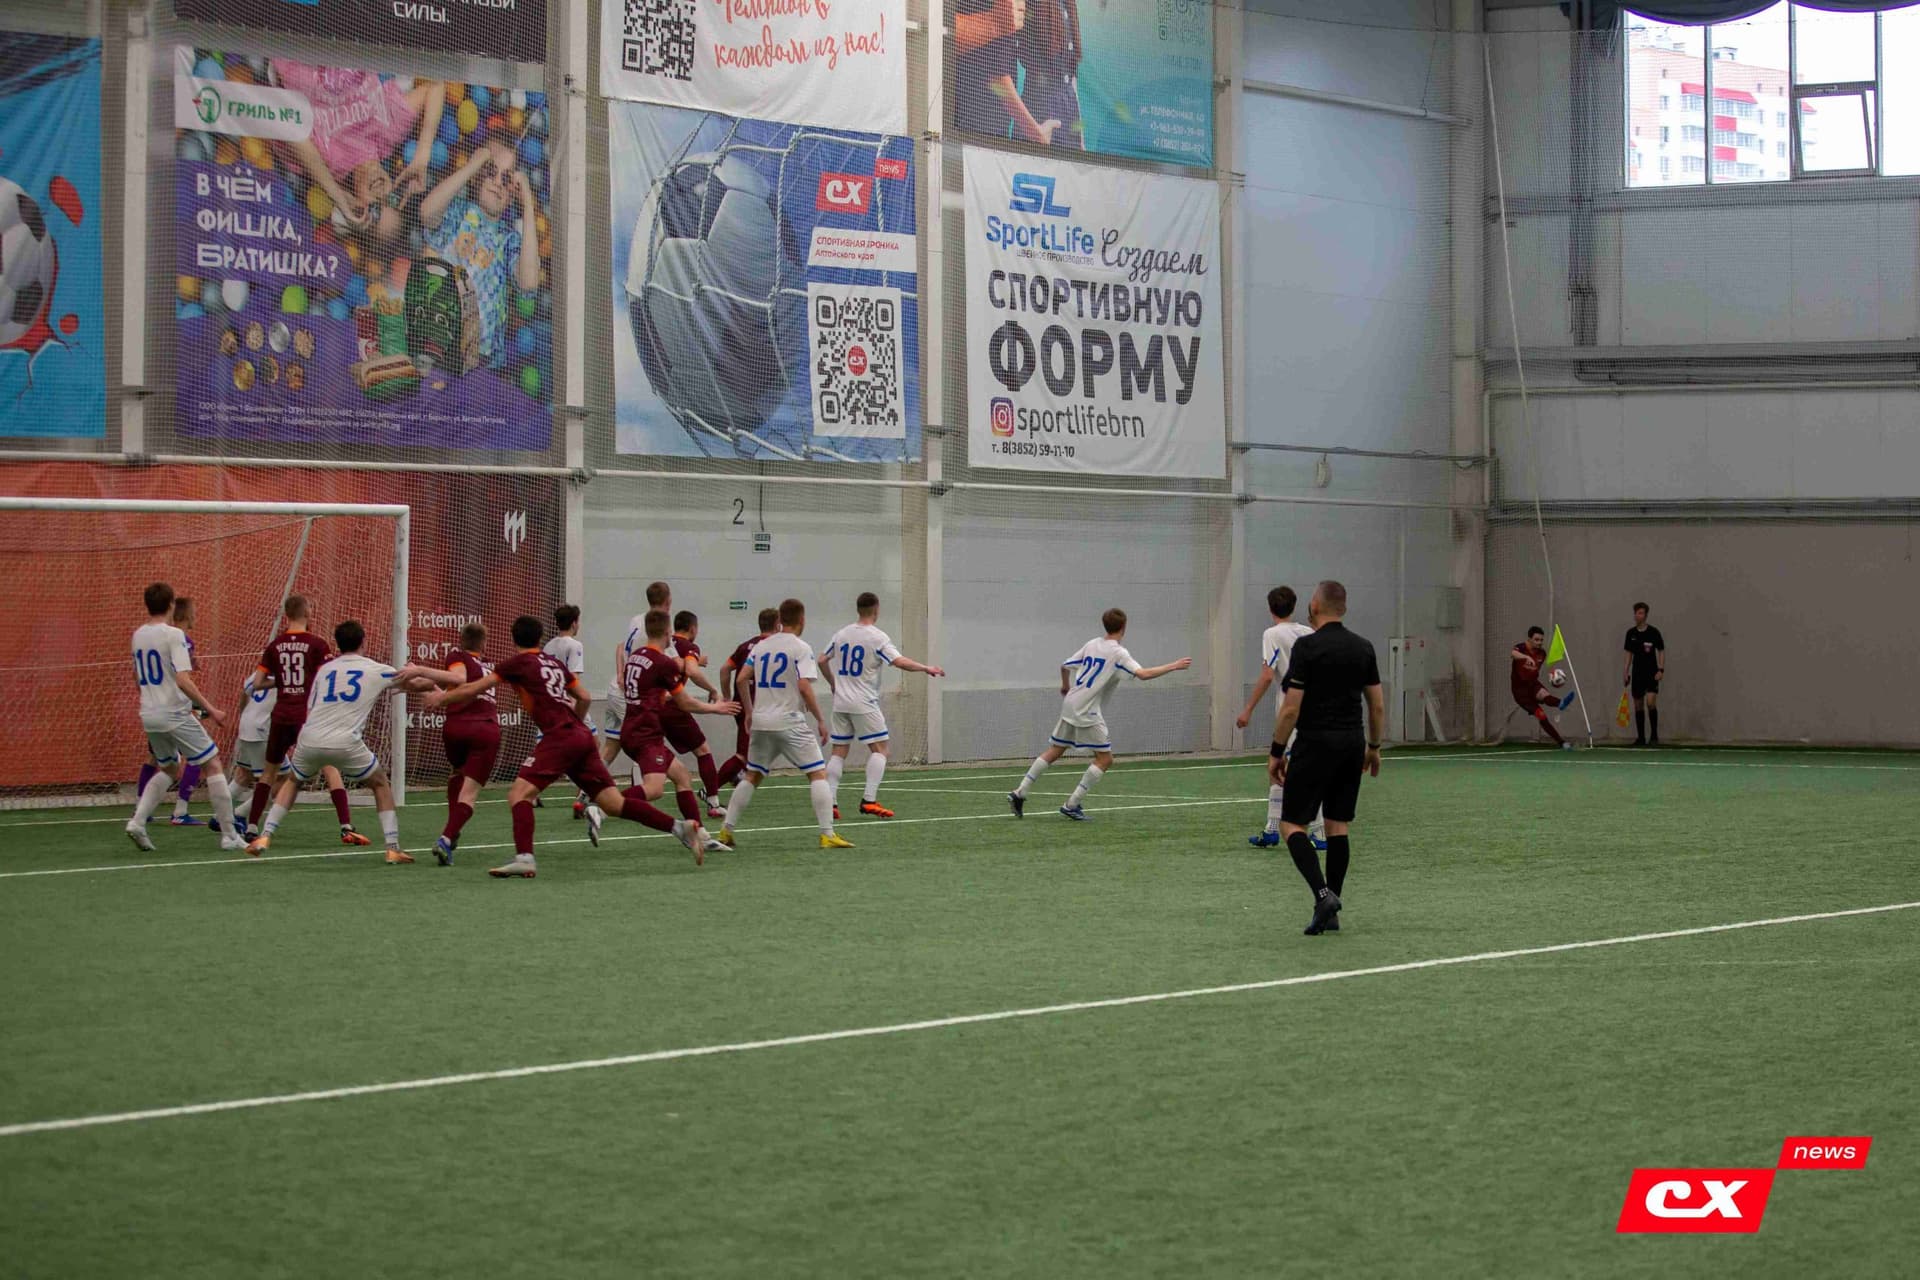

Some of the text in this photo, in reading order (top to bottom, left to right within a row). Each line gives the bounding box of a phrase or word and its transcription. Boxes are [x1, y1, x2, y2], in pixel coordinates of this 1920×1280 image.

[393, 1, 450, 23] СИЛЫ.
[714, 13, 885, 70] каждом из нас!
[228, 101, 303, 125] ГРИЛЬ №1
[196, 167, 272, 203] В ЧЁМ
[197, 209, 302, 246] ФИШКА,
[816, 237, 865, 248] СПОРТИВНАЯ
[986, 216, 1094, 254] SportLife
[197, 243, 338, 278] БРАТИШКА?
[1101, 227, 1208, 282] Создаем
[988, 269, 1202, 328] СПОРТИВНУЮ
[988, 320, 1201, 405] ФОРМУ
[1017, 405, 1145, 439] sportlifebrn
[1002, 442, 1038, 457] 8(3852)
[1039, 445, 1076, 458] 59-11-10
[733, 498, 744, 525] 2
[136, 649, 163, 686] 10
[417, 642, 438, 660] ФК
[838, 642, 865, 677] 18
[280, 652, 304, 686] 33
[323, 670, 364, 702] 13
[757, 652, 788, 689] 12
[1076, 656, 1106, 688] 27
